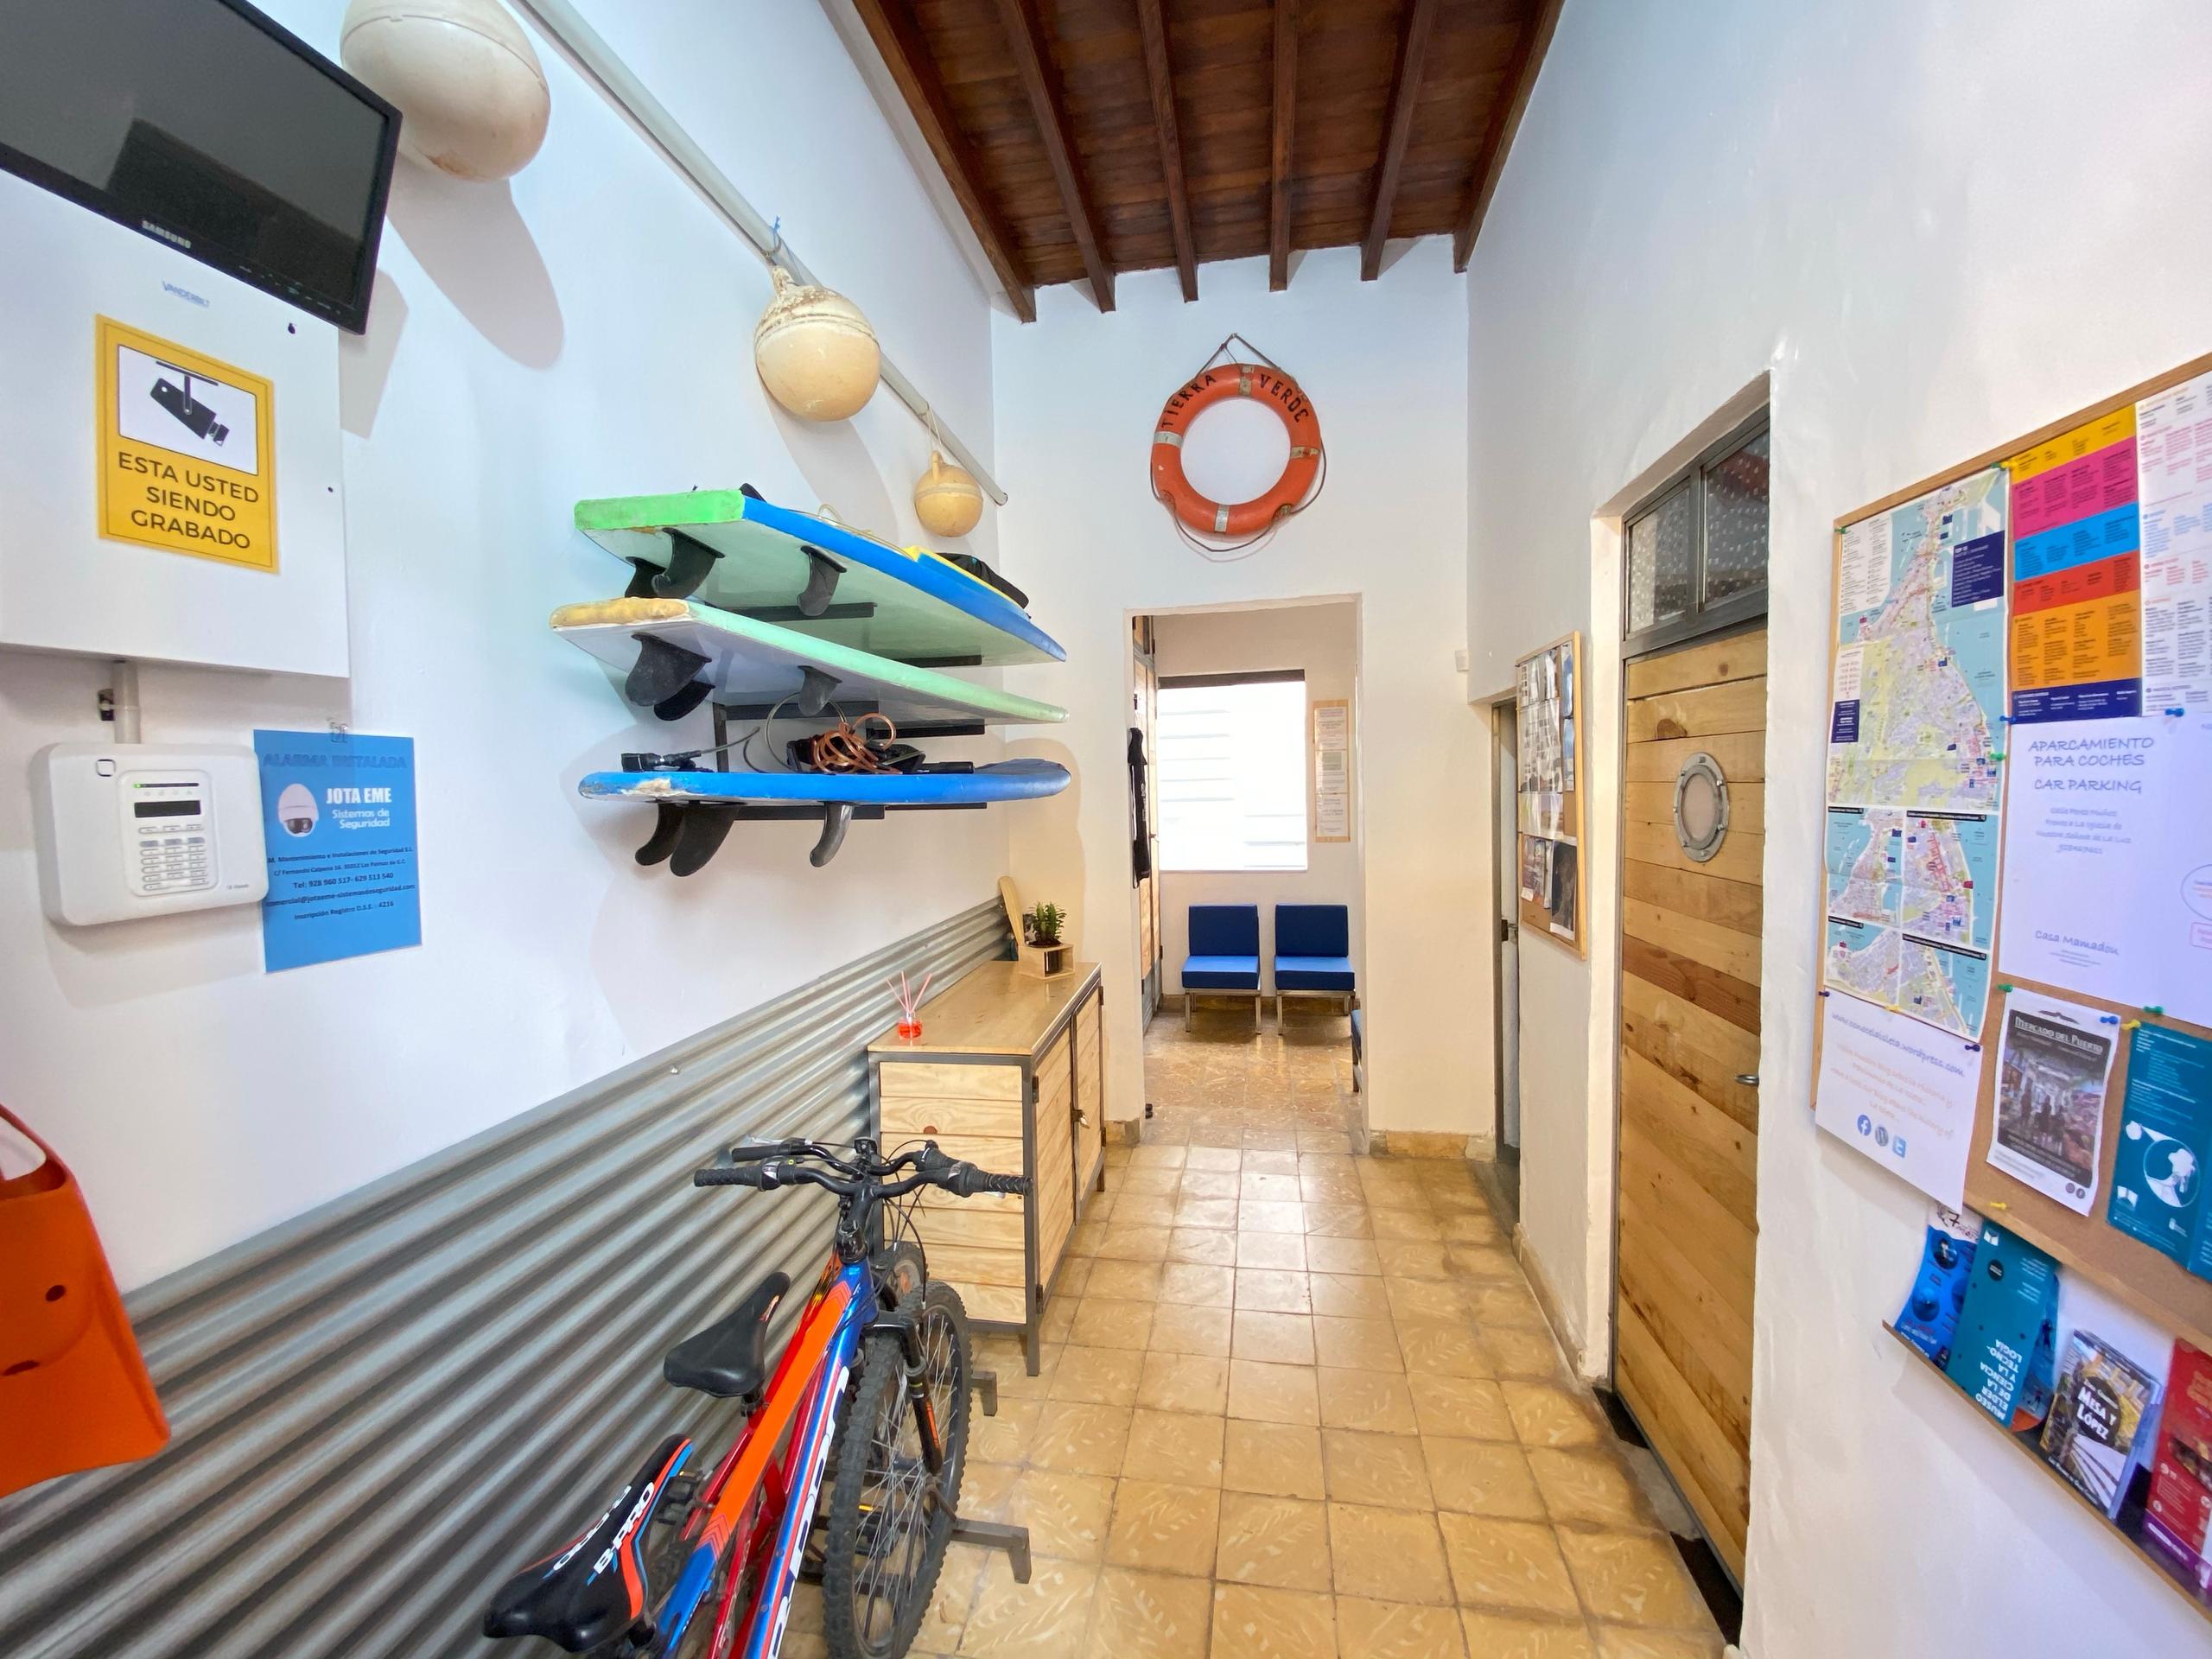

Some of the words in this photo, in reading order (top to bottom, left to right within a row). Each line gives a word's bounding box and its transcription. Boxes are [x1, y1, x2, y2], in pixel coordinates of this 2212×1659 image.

[142, 219, 192, 249] SAMSUNG
[1161, 374, 1217, 429] TIERRA
[1260, 373, 1309, 423] VERDE
[118, 451, 179, 483] ESTA
[186, 470, 259, 503] USTED
[146, 486, 236, 521] SIENDO
[130, 510, 251, 549] GRABADO
[2028, 737, 2154, 752] APARCAMIENTO
[263, 753, 328, 767] ALARMA
[331, 754, 408, 769] INSTALADA
[2034, 756, 2075, 766] PARA
[2078, 754, 2145, 766] COCHES
[326, 788, 361, 804] JOTA
[364, 788, 392, 804] EME
[2034, 779, 2065, 791] CAR
[2068, 779, 2142, 793] PARKING
[332, 809, 375, 819] Sistemas
[378, 809, 390, 817] de
[340, 818, 391, 830] Seguridad
[1980, 1361, 2015, 1392] CIENCIA
[1974, 1392, 2006, 1421] MUSEO
[1980, 1385, 2009, 1413] ELDER
[1998, 1387, 2012, 1402] DE
[2077, 1386, 2107, 1421] MESA
[2108, 1413, 2117, 1427] Y
[2076, 1402, 2110, 1440] LÓPEZ
[594, 1482, 654, 1574] B-PRO
